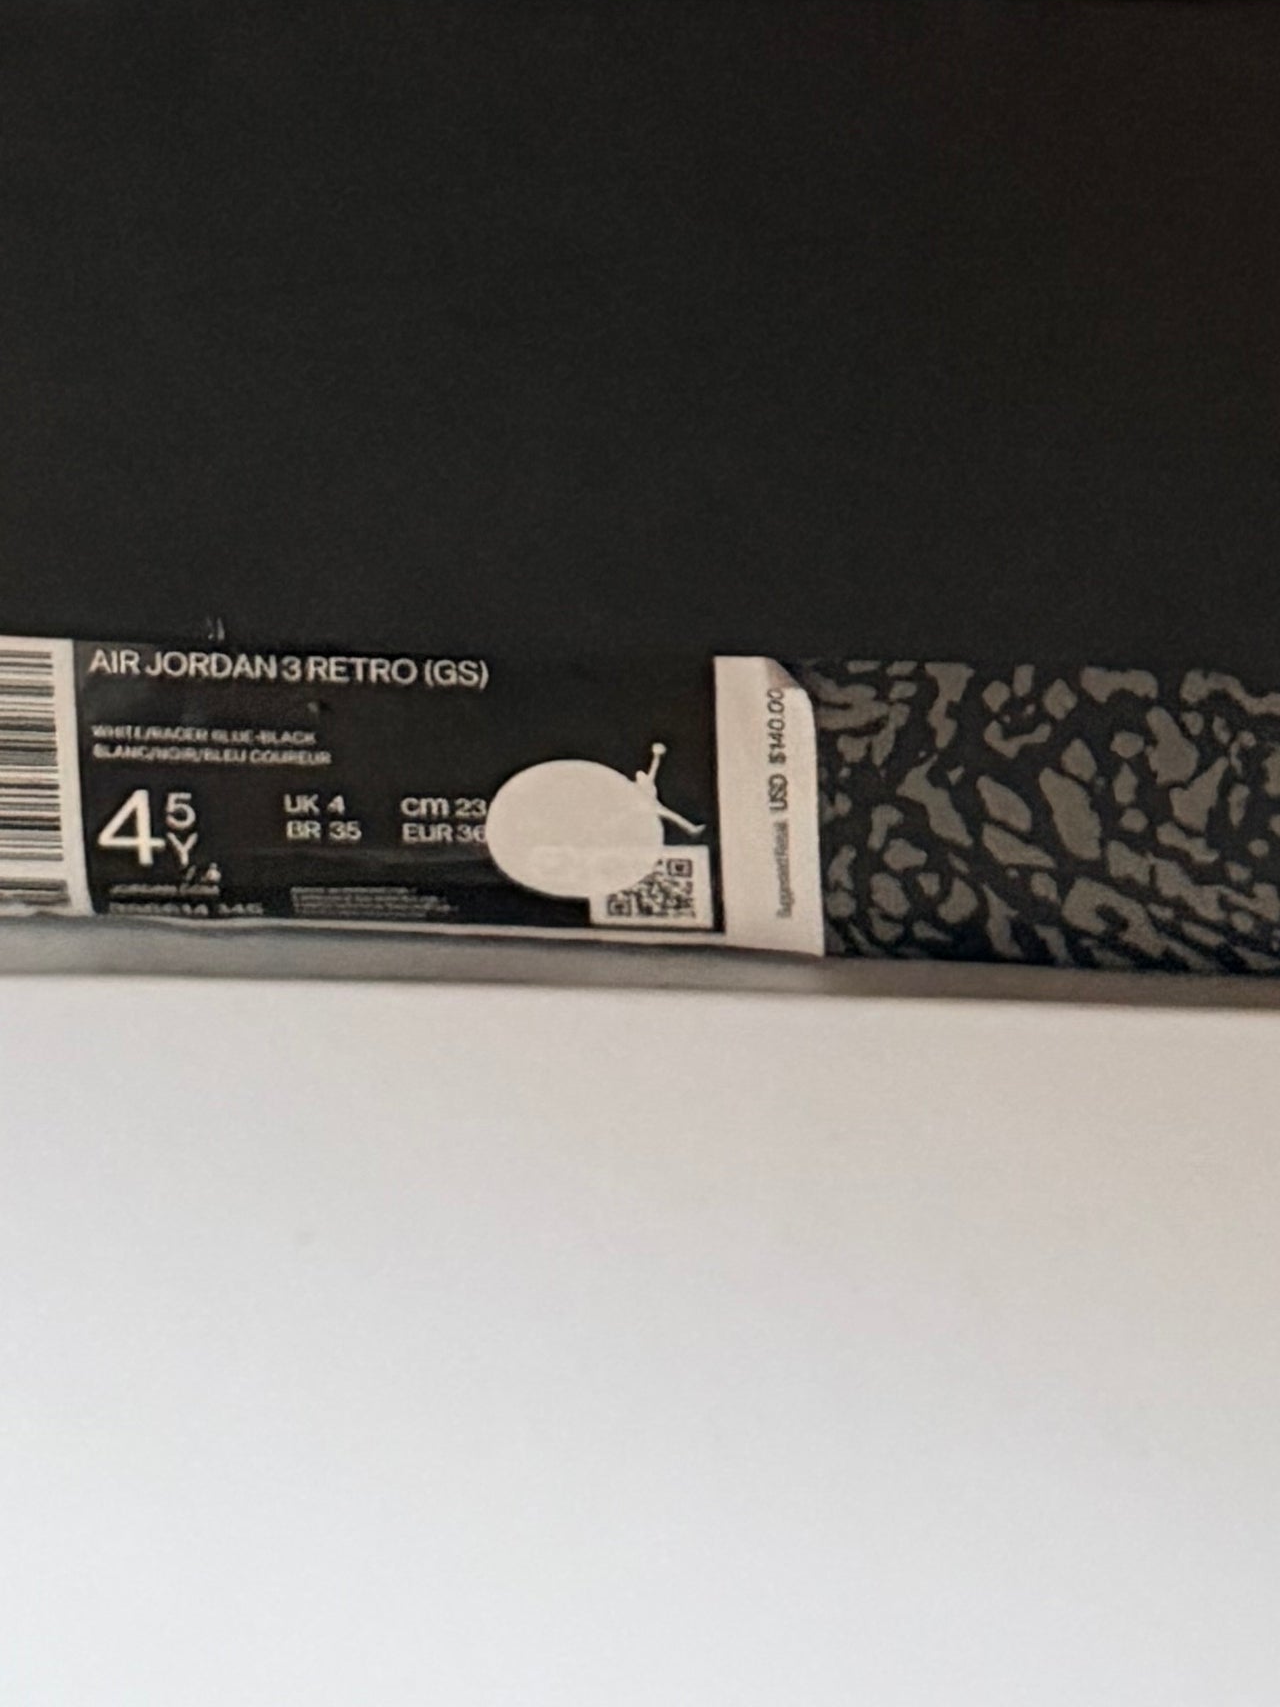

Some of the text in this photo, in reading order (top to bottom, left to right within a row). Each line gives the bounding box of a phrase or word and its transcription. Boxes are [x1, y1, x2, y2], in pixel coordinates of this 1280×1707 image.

[89, 649, 490, 689] AIR JORDAN 3 RETRO (GS)
[766, 687, 787, 765] $140.00
[283, 794, 345, 815] UK 4
[767, 773, 789, 812] USD
[285, 821, 362, 842] BR 35
[401, 823, 453, 844] EUR
